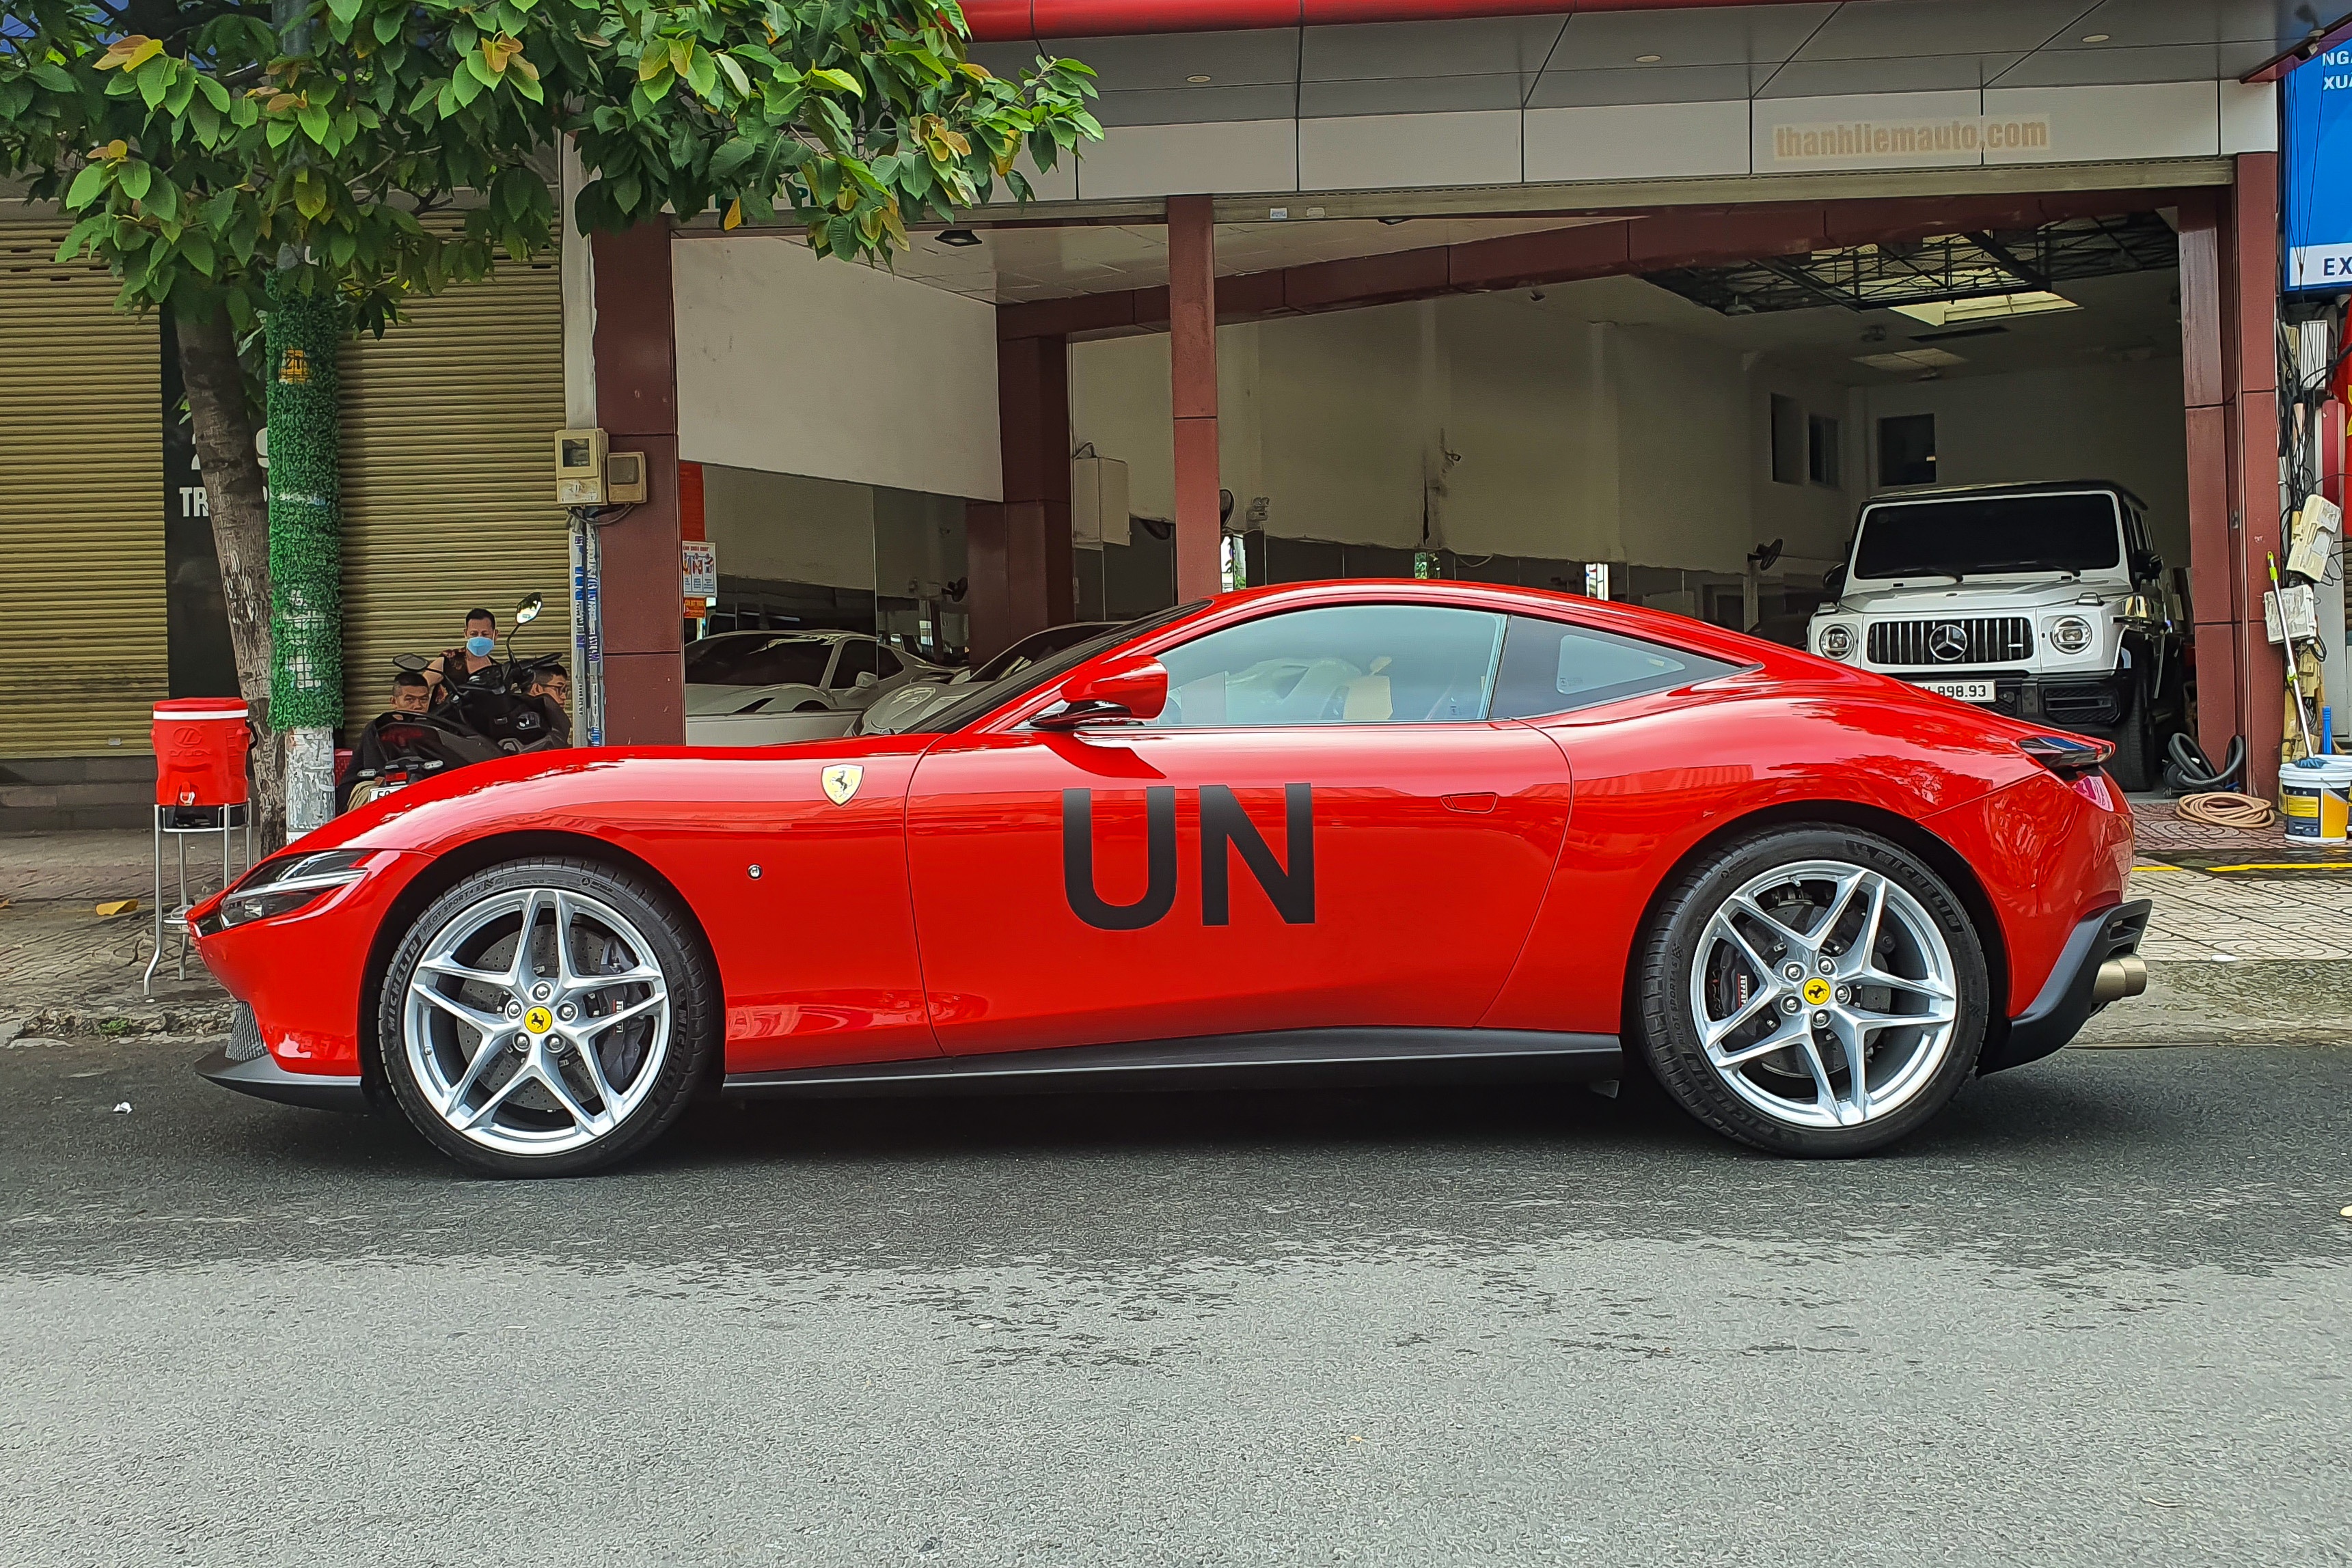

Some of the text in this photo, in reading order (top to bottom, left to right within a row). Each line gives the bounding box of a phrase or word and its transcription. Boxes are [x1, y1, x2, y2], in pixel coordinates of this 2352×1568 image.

[2322, 51, 2352, 66] NG
[1777, 121, 2047, 158] thanhliemauto.com
[1062, 782, 1315, 931] UN
[1874, 852, 1960, 927] MICHELIN
[422, 911, 442, 933] PILOT
[444, 891, 469, 913] SPORT
[387, 939, 419, 1032] MICHELIN
[1671, 1015, 1686, 1045] PILOT
